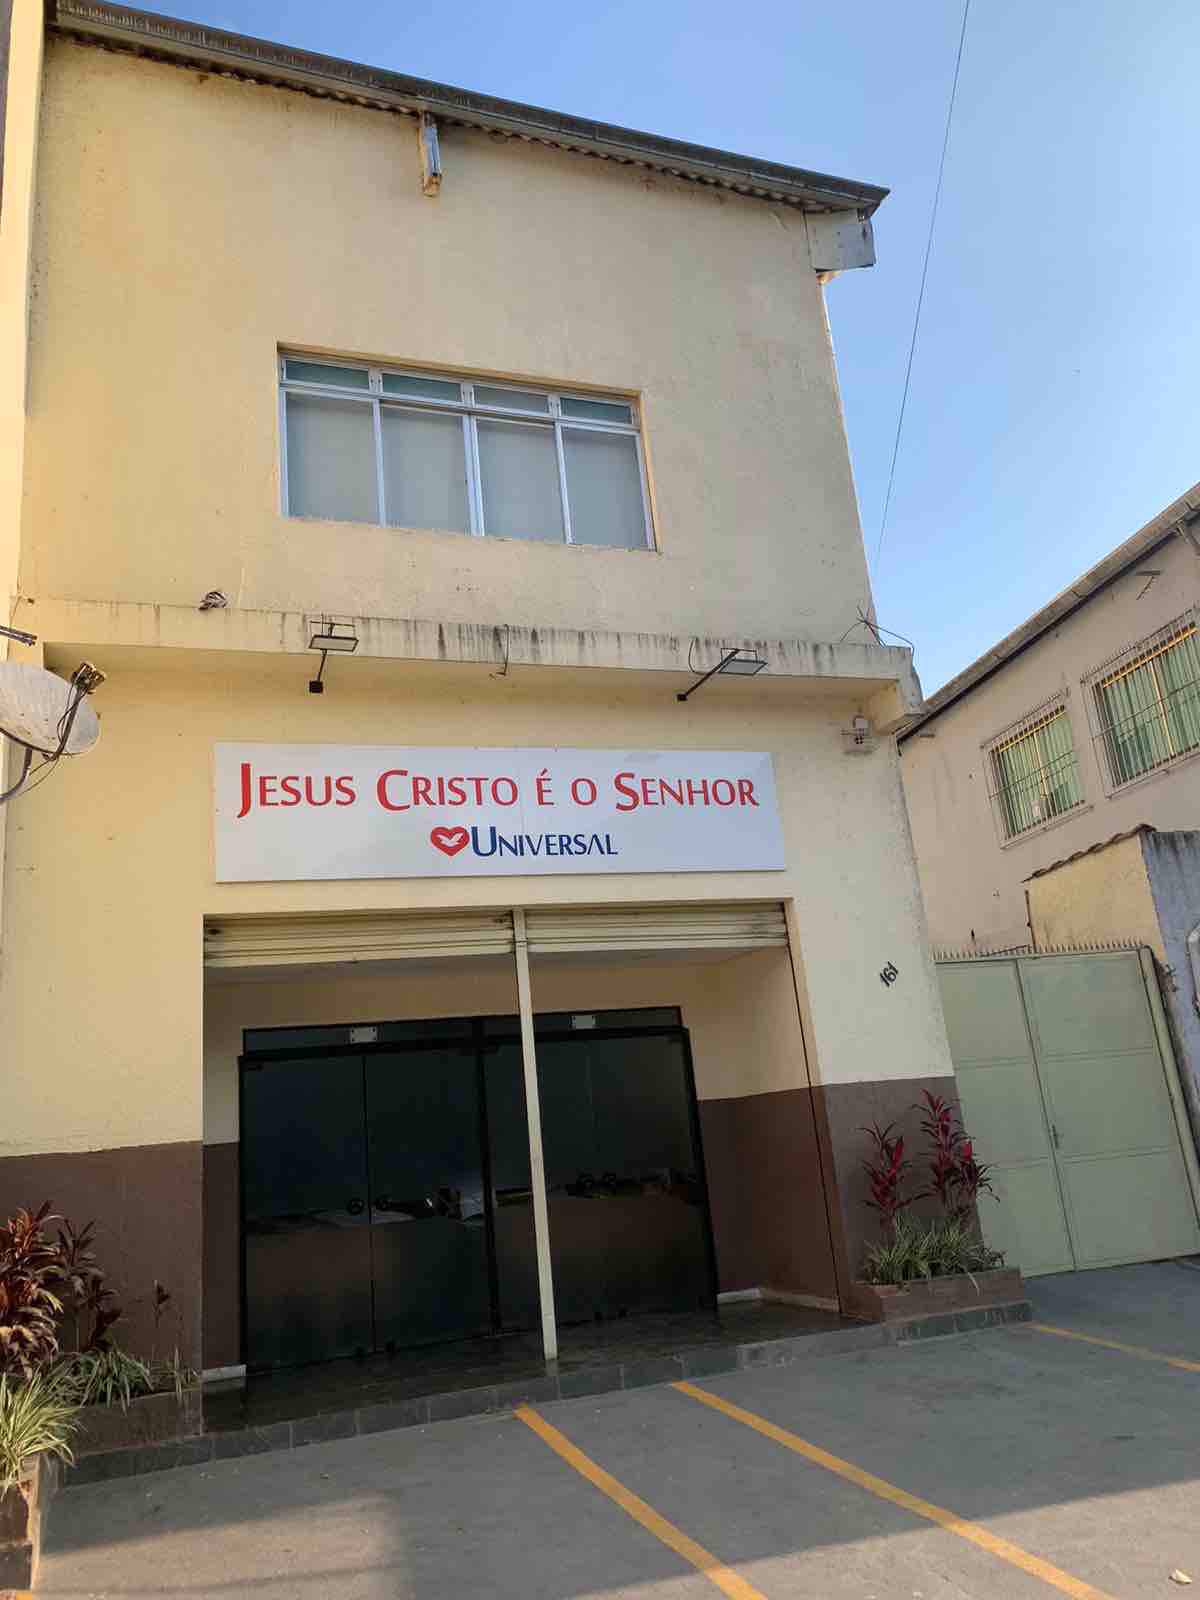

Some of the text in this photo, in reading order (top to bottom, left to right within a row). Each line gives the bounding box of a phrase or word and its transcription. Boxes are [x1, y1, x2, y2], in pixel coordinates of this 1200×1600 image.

[237, 762, 760, 818] JESUS CRISTO É O SENHOR
[471, 825, 619, 858] UNIVERSAL
[879, 960, 899, 988] 161
